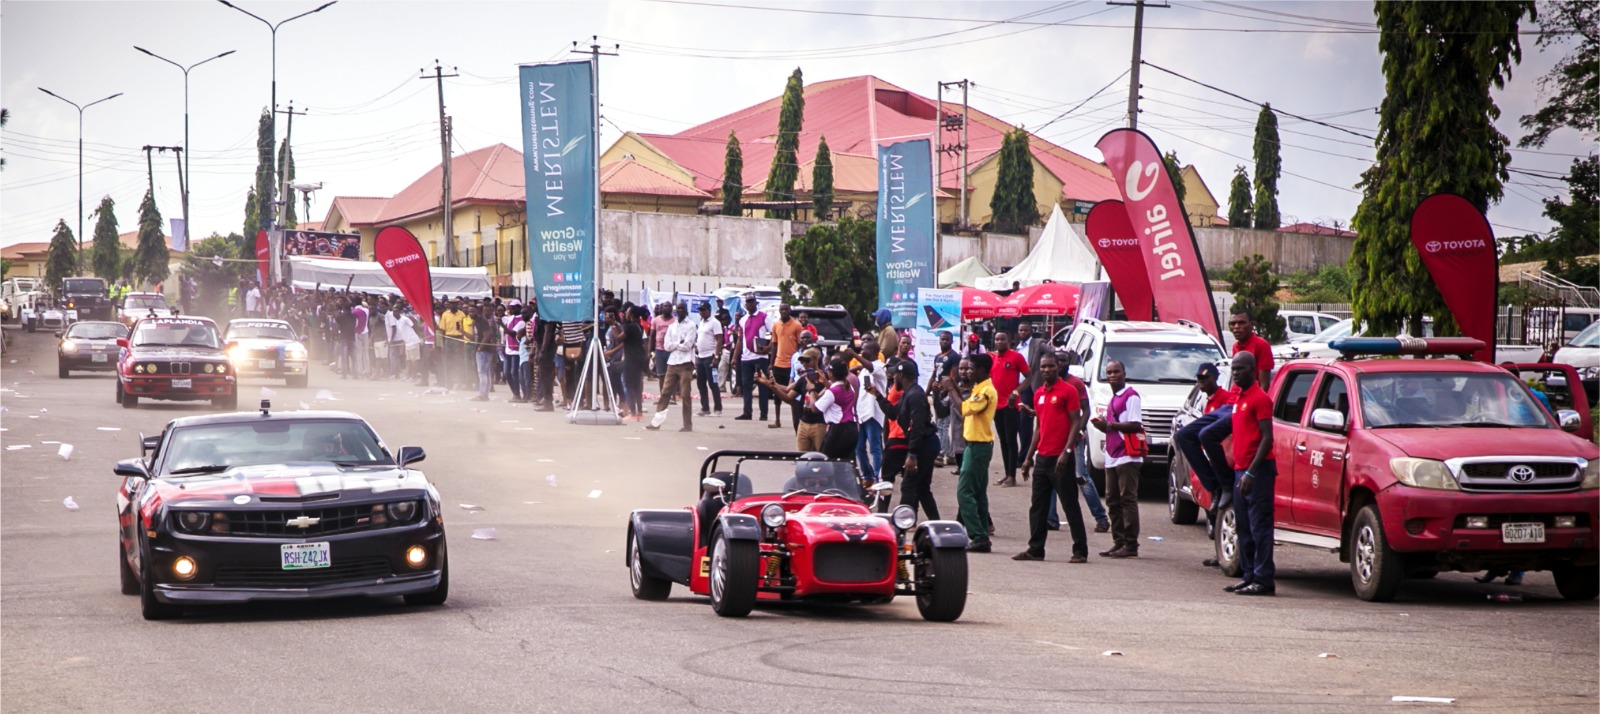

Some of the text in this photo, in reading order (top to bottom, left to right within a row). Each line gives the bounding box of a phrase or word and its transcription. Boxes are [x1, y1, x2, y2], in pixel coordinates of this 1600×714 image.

[1111, 238, 1139, 246] TOYOT
[1144, 203, 1185, 281] airtel
[1442, 239, 1486, 250] TOYOTA
[394, 252, 420, 264] TOYOTA
[246, 322, 288, 330] FORZA
